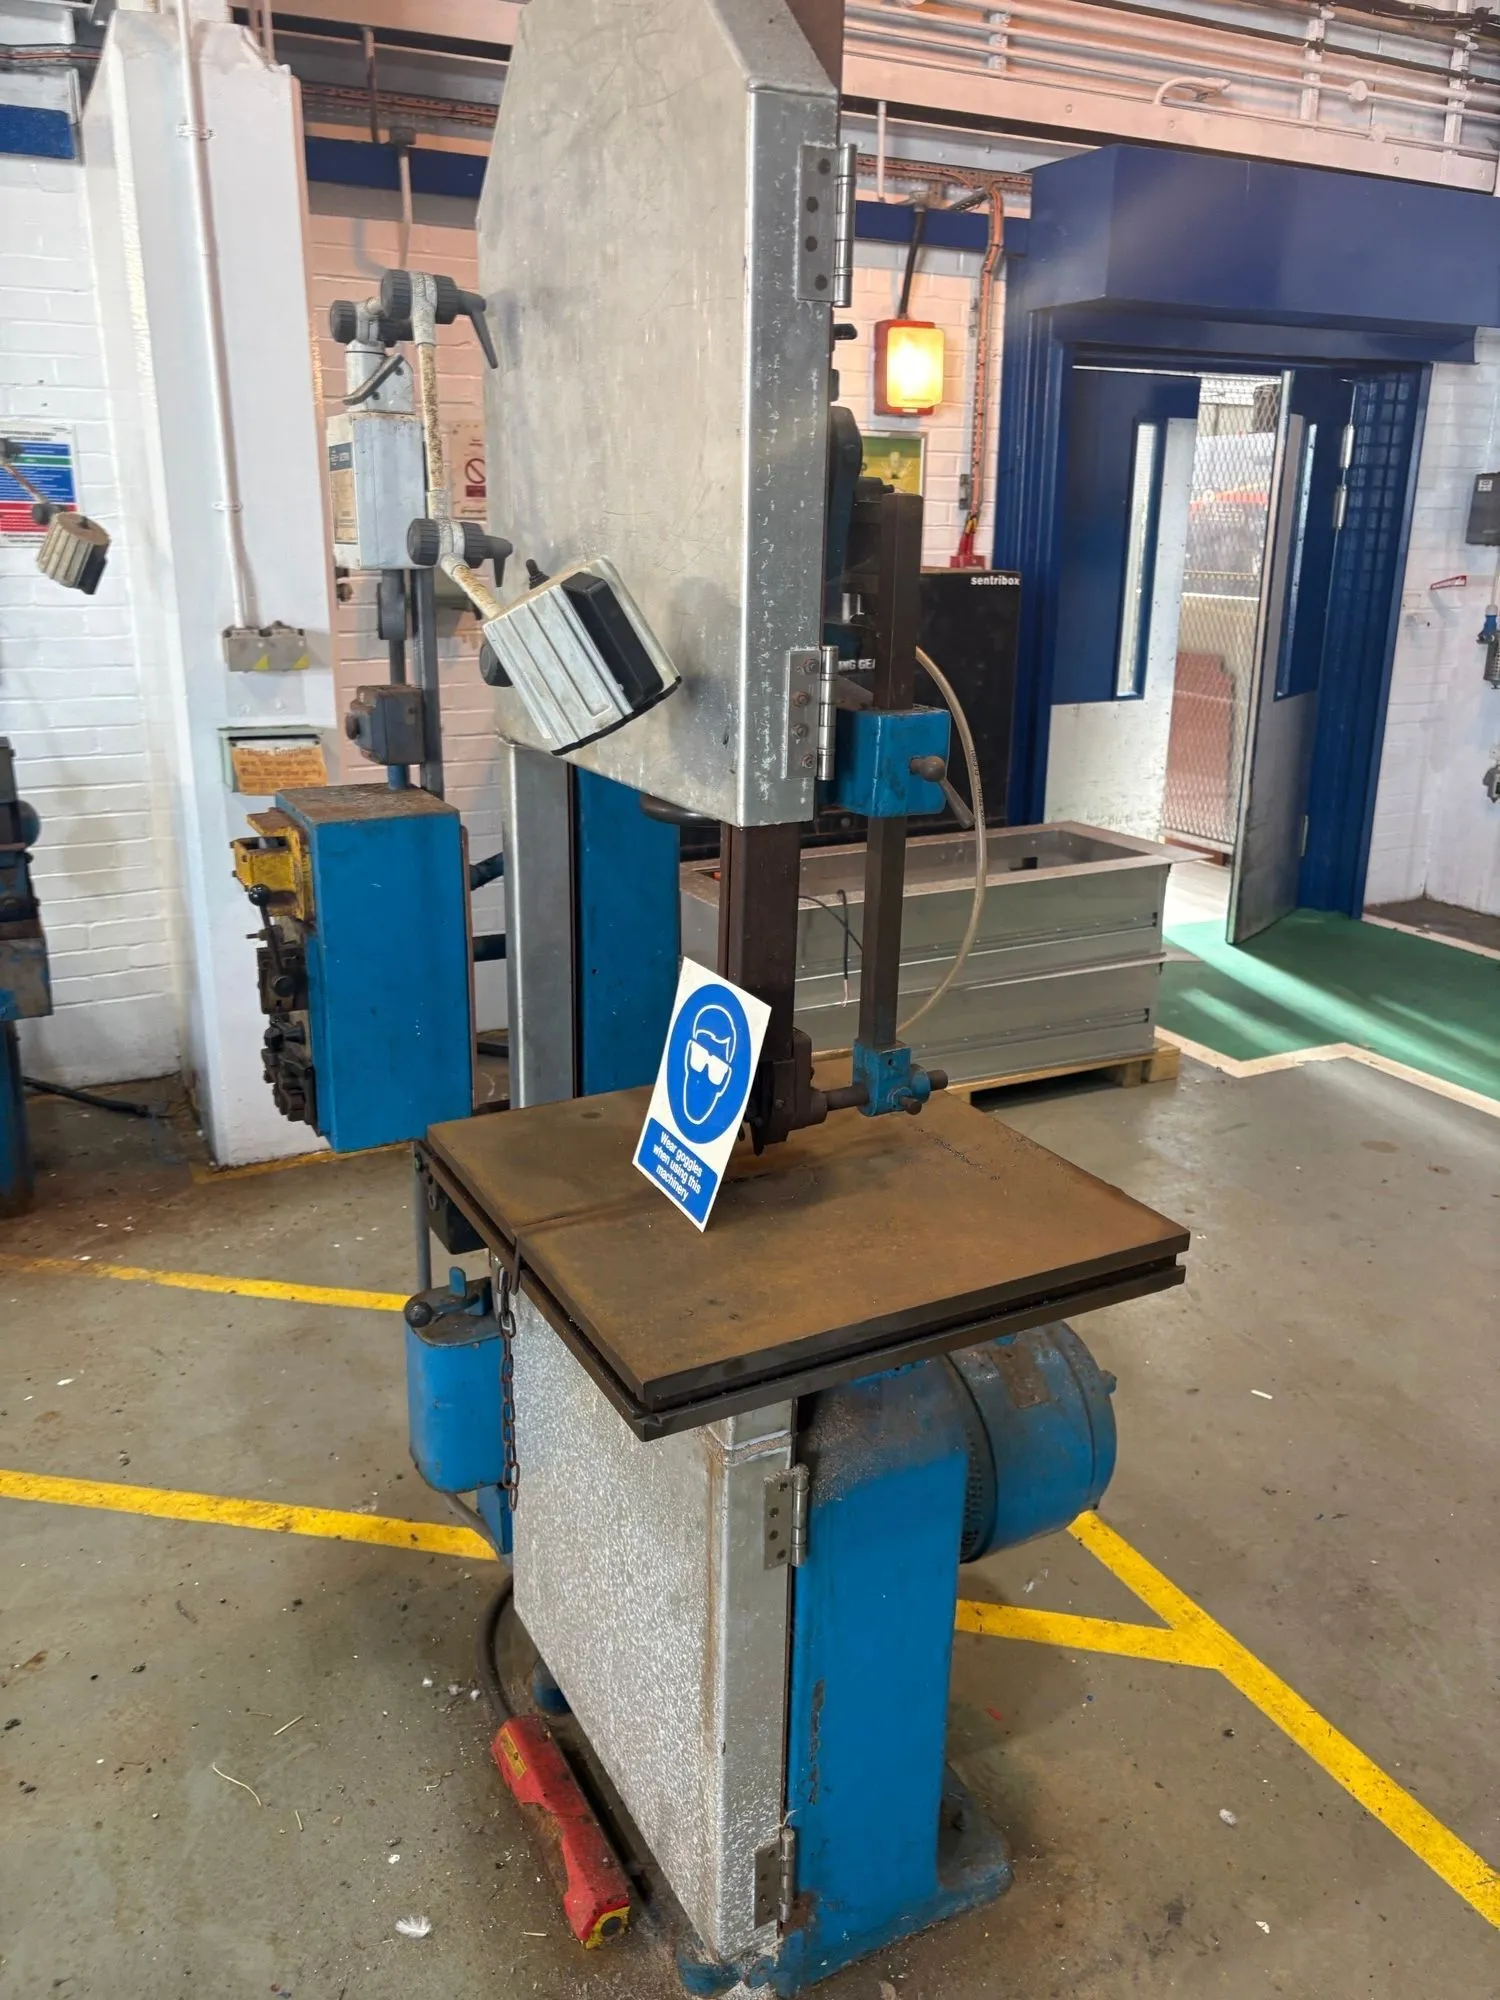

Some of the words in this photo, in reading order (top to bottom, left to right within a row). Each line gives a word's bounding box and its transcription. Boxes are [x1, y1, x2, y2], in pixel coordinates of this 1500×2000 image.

[971, 575, 1021, 586] sentribox
[653, 1143, 671, 1165] when
[670, 1160, 688, 1184] using
[688, 1174, 702, 1195] this
[661, 1131, 677, 1153] Wear
[675, 1149, 702, 1178] goggles
[656, 1165, 689, 1202] machinery
